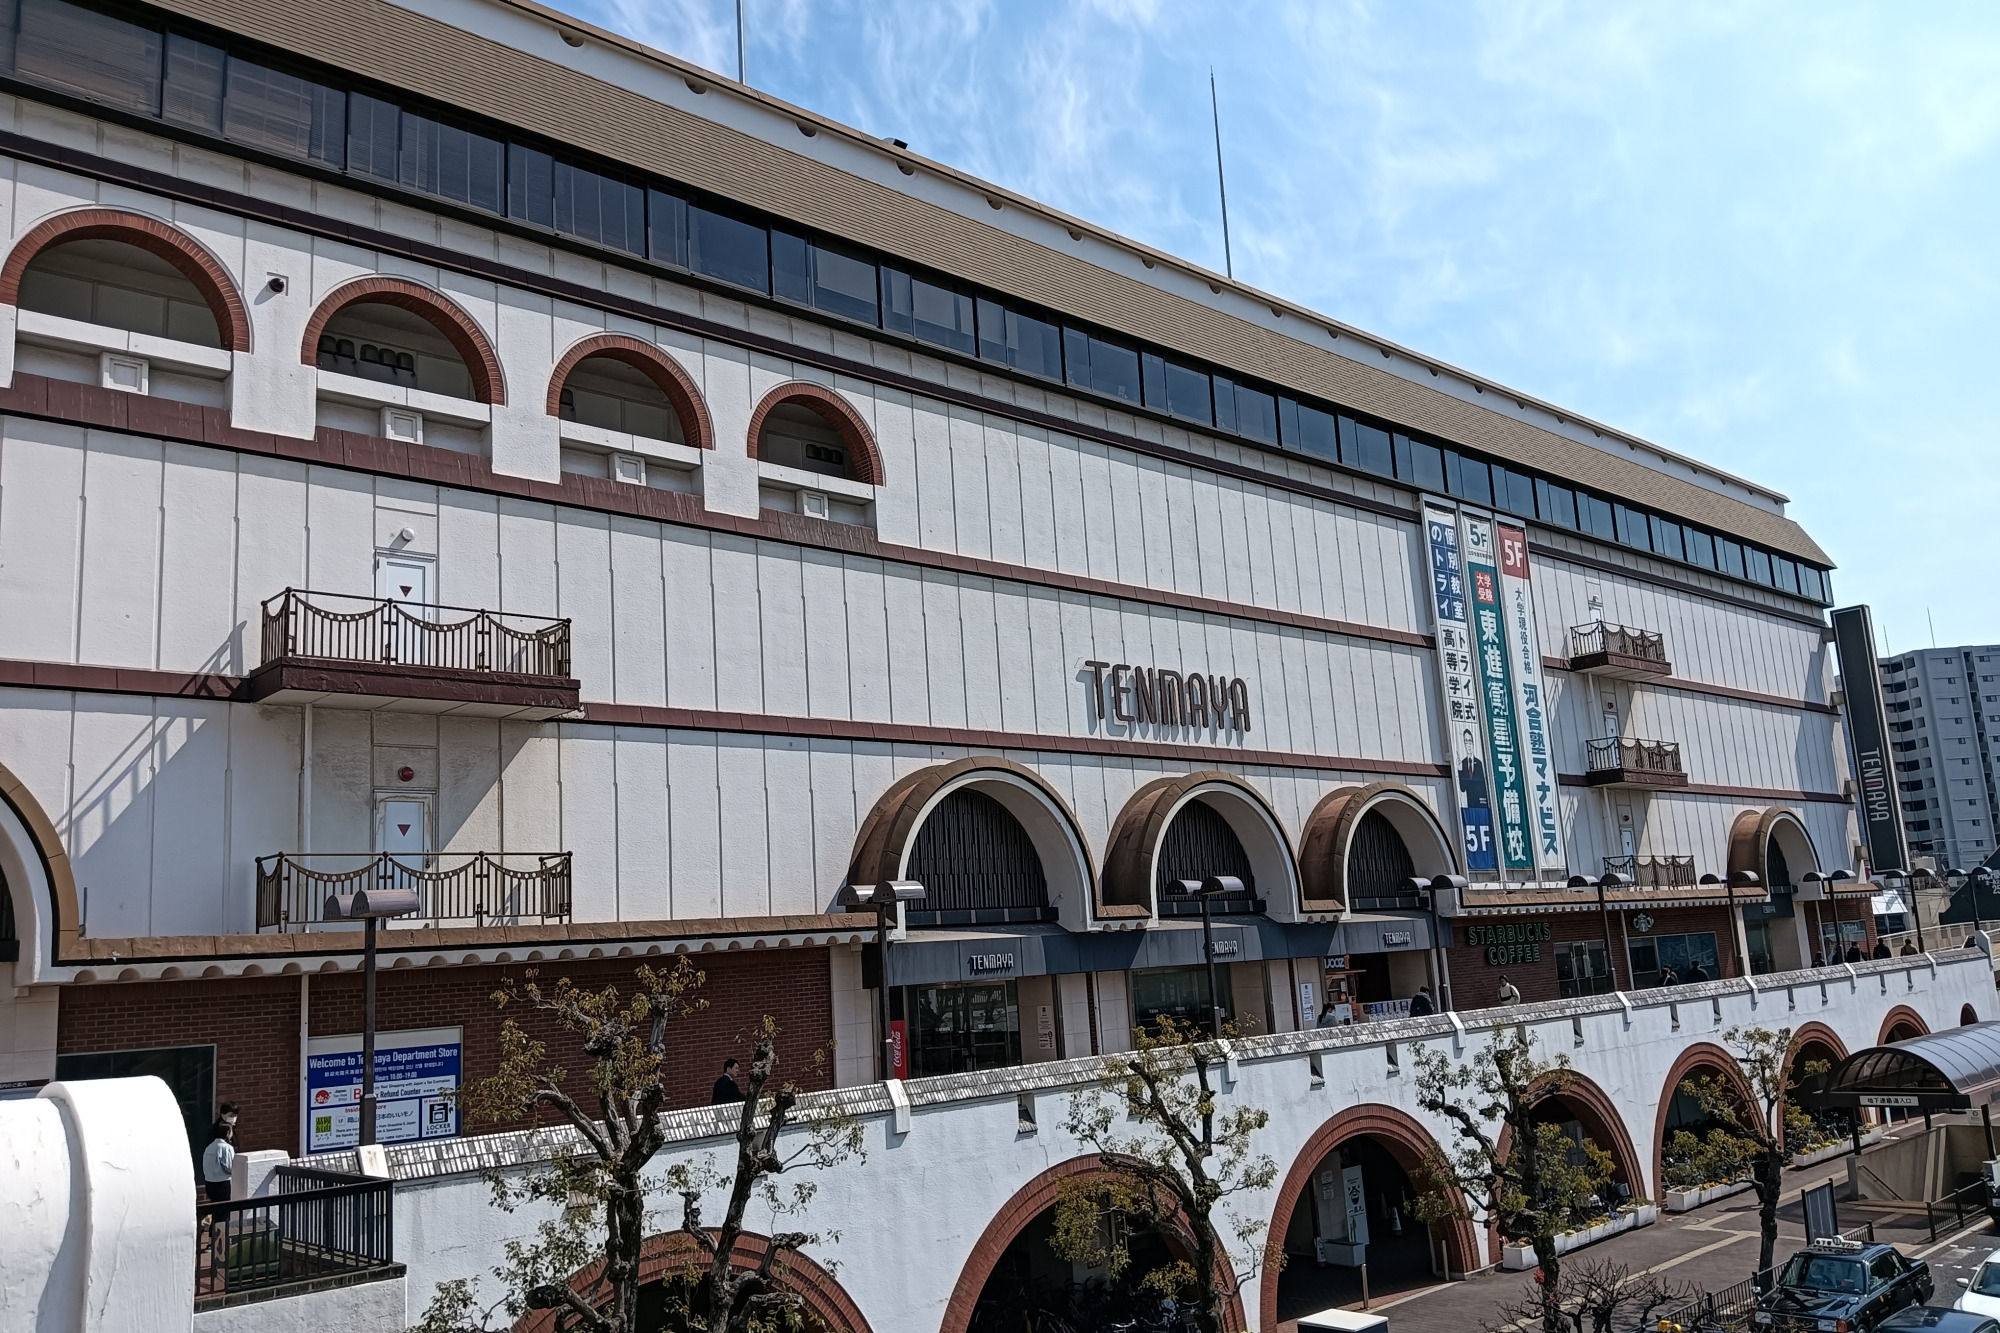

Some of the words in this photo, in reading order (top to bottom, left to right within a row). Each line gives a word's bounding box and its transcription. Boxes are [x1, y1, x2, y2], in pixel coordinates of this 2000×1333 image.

[1470, 523, 1487, 548] 5F
[1504, 538, 1524, 568] 5F
[1431, 525, 1449, 617] のトライ
[1445, 527, 1464, 620] 個別教室
[1476, 573, 1491, 588] 大学
[1478, 588, 1494, 602] 受験
[1515, 587, 1532, 675] 大学現役合格
[1443, 628, 1463, 720] 高等学院
[1458, 631, 1476, 721] トライ式
[1084, 660, 1252, 732] TENMAYA
[1480, 609, 1527, 861] 東進衛星予備校
[1523, 682, 1559, 856] 河合塾マナビス
[1860, 747, 1890, 821] TENMAYA
[1466, 825, 1491, 852] 5F
[1211, 940, 1238, 954] ENMAYA
[1384, 931, 1411, 944] TENMAYA
[1468, 922, 1551, 946] STARBUCKS
[971, 953, 1014, 970] TENMAYA
[1488, 943, 1541, 965] COFFEE
[309, 1057, 345, 1069] Welcome
[348, 1056, 355, 1066] to
[393, 1049, 437, 1063] Department
[438, 1047, 458, 1058] Store
[380, 1089, 400, 1098] Refund
[400, 1087, 421, 1097] Counter
[426, 1122, 451, 1131] LOCKER
